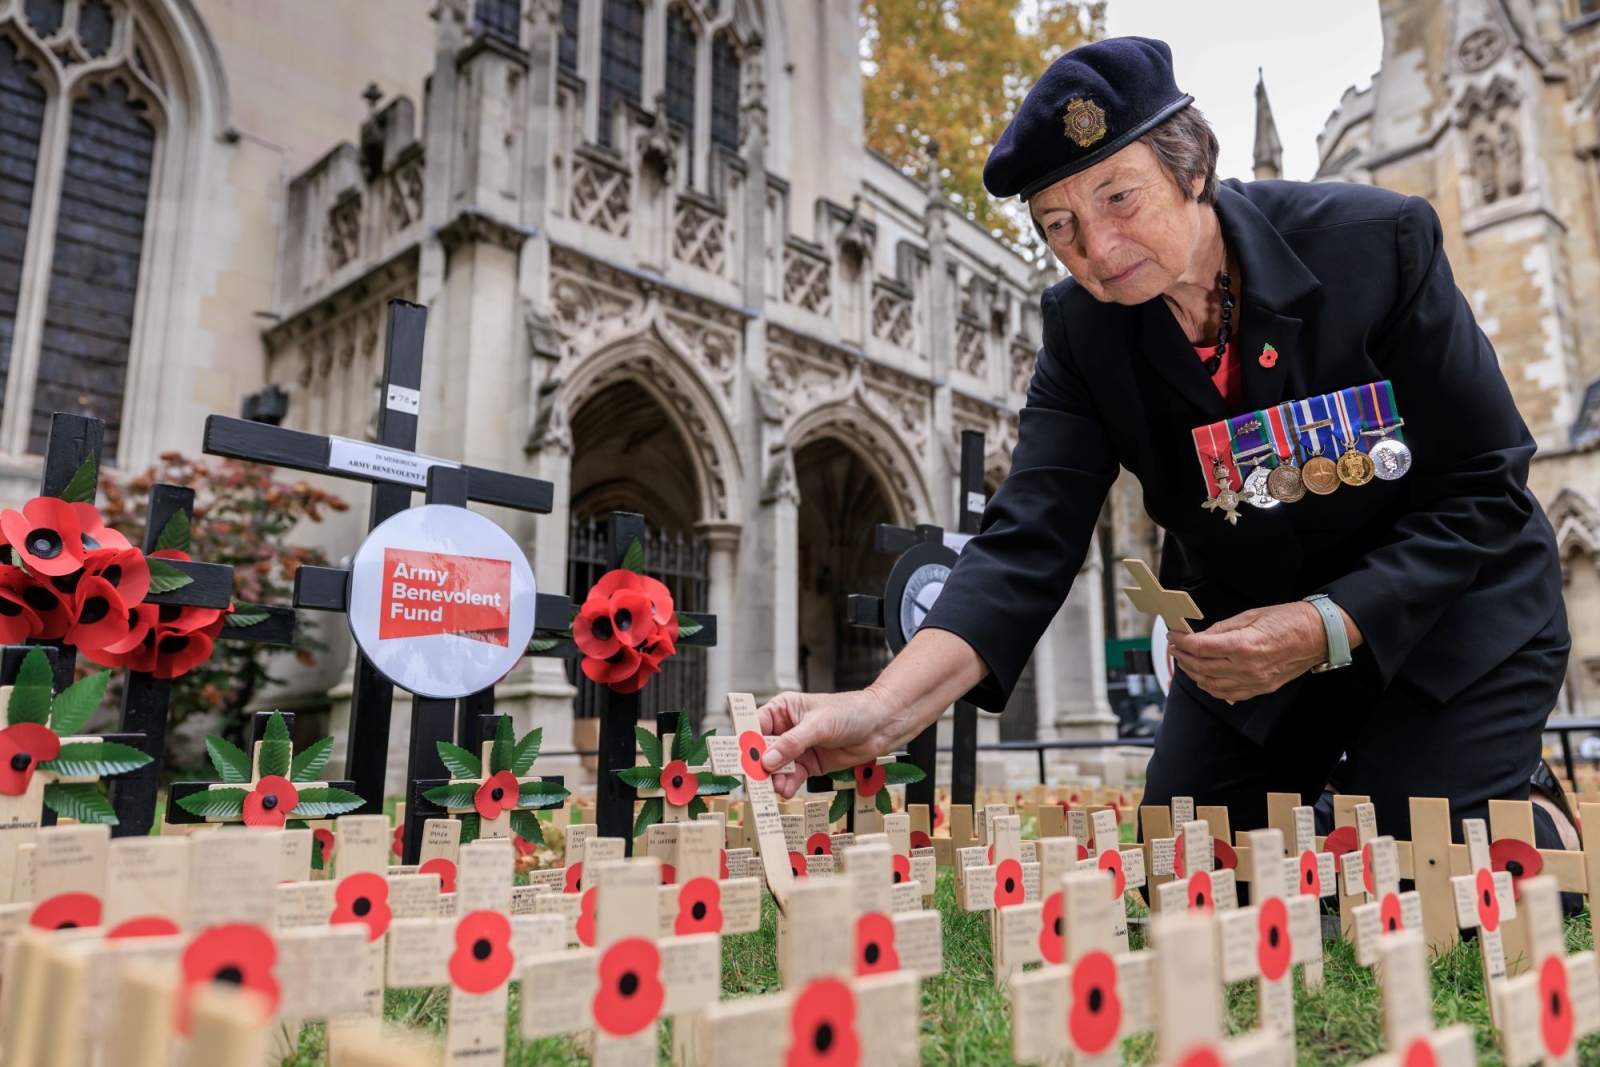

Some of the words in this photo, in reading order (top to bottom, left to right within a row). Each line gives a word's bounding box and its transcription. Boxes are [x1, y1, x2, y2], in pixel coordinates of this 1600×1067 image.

[375, 453, 383, 461] IN
[348, 460, 371, 469] ARMY
[371, 464, 421, 480] BENEVOLENT
[392, 562, 449, 587] Army
[391, 582, 502, 607] Benevolent
[390, 602, 443, 623] Fund
[0, 821, 38, 830] MEMBRANCE
